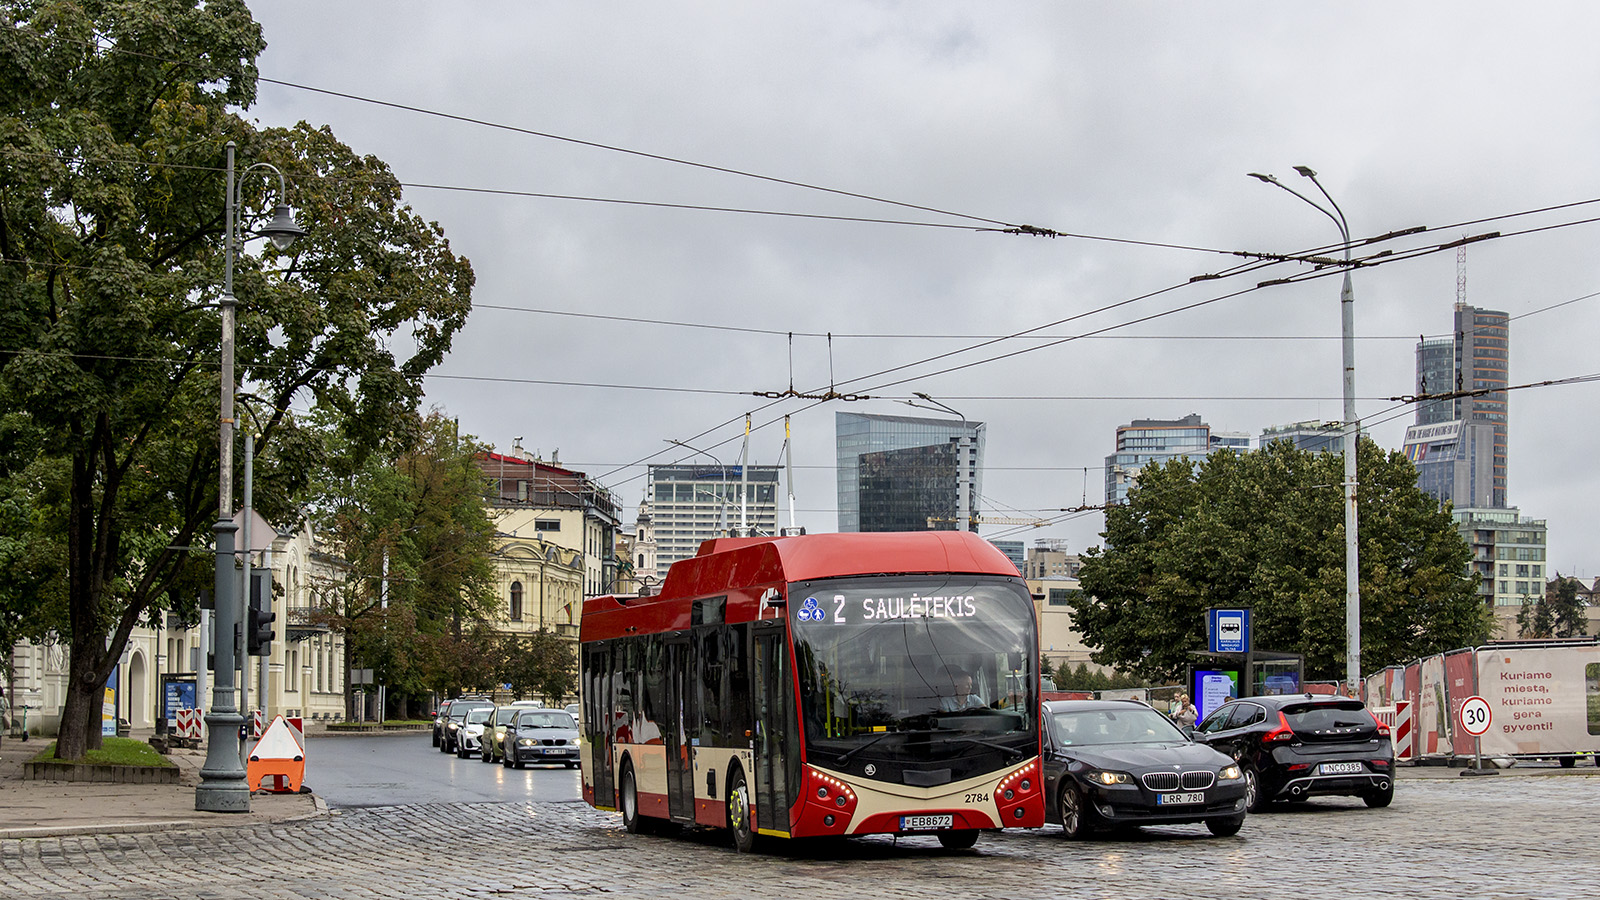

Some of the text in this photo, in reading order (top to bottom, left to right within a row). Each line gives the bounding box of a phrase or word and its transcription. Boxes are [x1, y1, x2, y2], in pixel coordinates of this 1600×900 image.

[833, 593, 976, 623] 2 SAULĖTEKIS
[1500, 672, 1552, 680] Kuriame
[1504, 684, 1549, 694] miestą,
[1501, 697, 1552, 706] kuriame
[1466, 707, 1485, 725] 30
[1513, 711, 1542, 720] gera
[1502, 722, 1553, 733] gyventi!
[964, 793, 989, 803] 2784
[1162, 793, 1203, 803] LRR 780
[911, 816, 950, 826] EB8672
